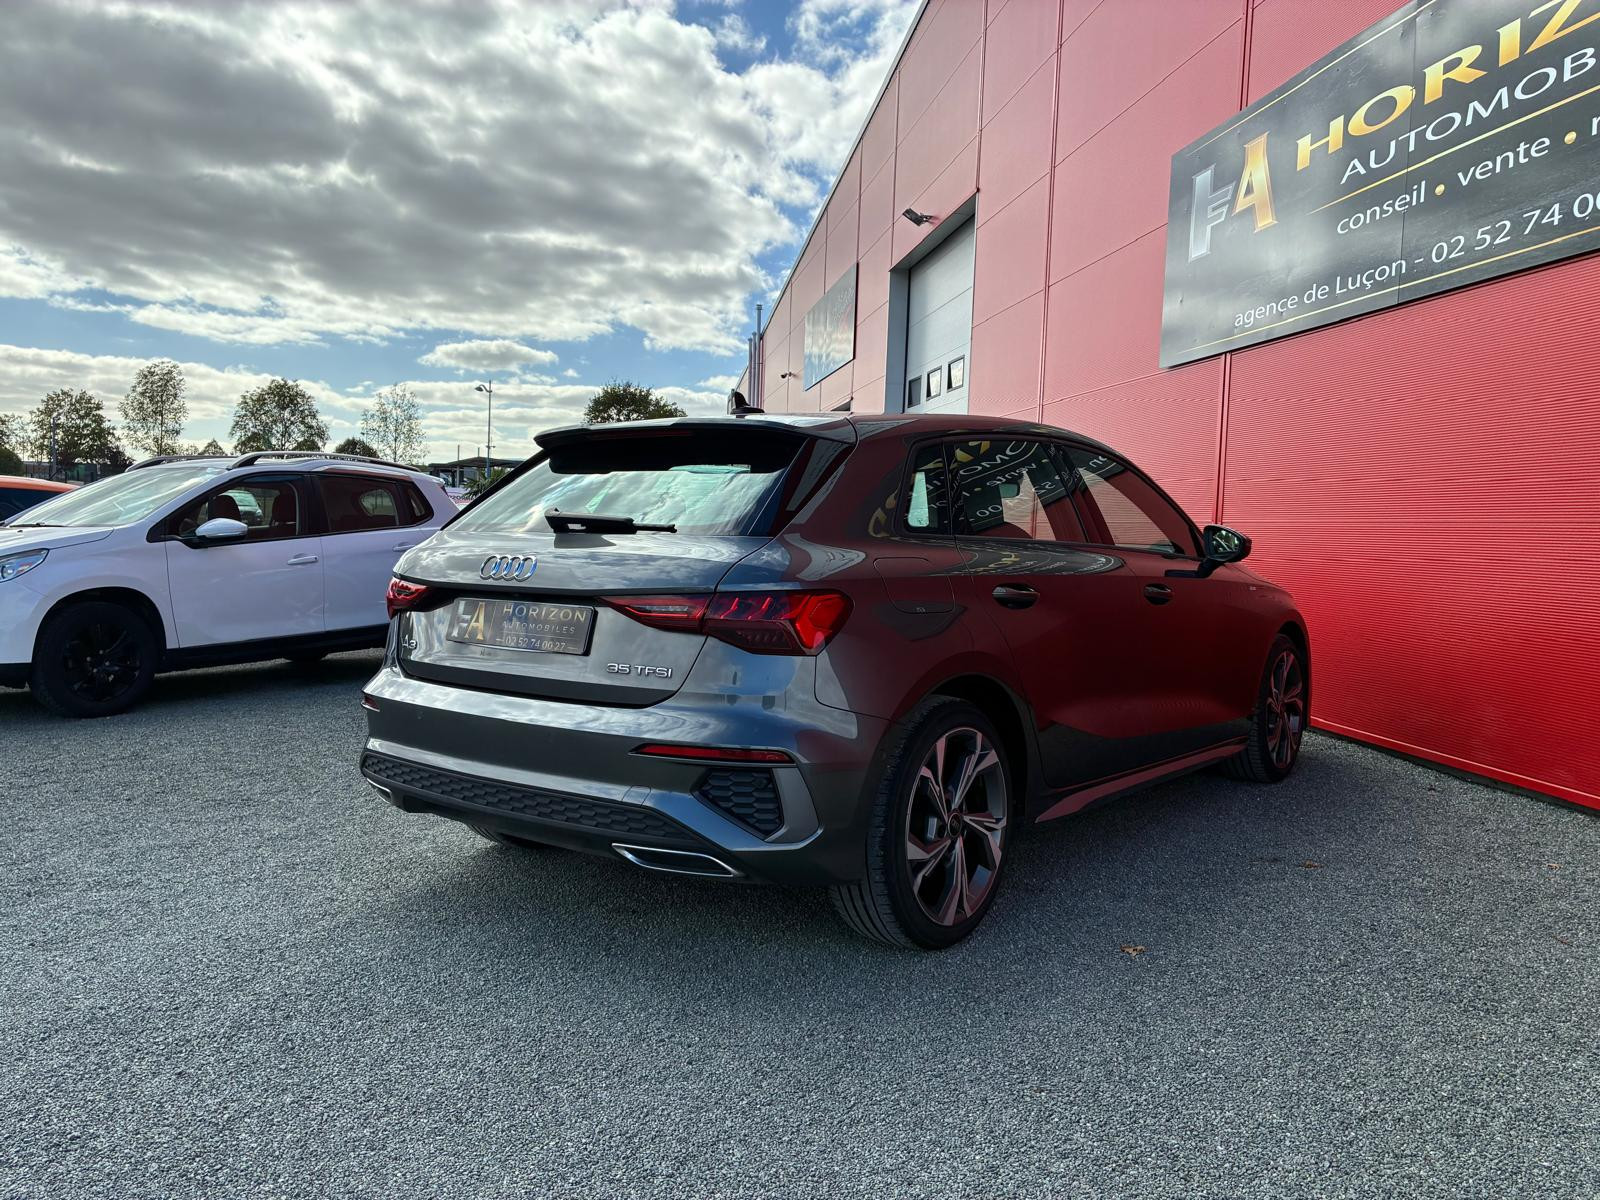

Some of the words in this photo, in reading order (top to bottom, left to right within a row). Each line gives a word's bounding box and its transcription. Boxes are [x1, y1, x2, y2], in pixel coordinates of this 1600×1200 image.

[1297, 0, 1600, 171] HORIZ
[1340, 47, 1597, 184] AUTOMOB
[1336, 181, 1426, 235] conseil
[1457, 137, 1551, 186] vente
[1234, 296, 1298, 328] agence
[1302, 283, 1330, 304] de
[1335, 258, 1407, 290] Luçon
[1431, 235, 1466, 264] 02
[1474, 220, 1511, 251] 52
[1523, 202, 1564, 235] 74
[502, 604, 587, 623] HORIZON
[502, 620, 576, 634] AUTOMOBILES
[505, 636, 517, 646] 02
[518, 638, 529, 647] 52
[530, 639, 541, 648] 74
[541, 640, 554, 650] 00
[554, 642, 566, 650] 27
[606, 663, 631, 674] 35
[634, 665, 673, 678] TFSI
